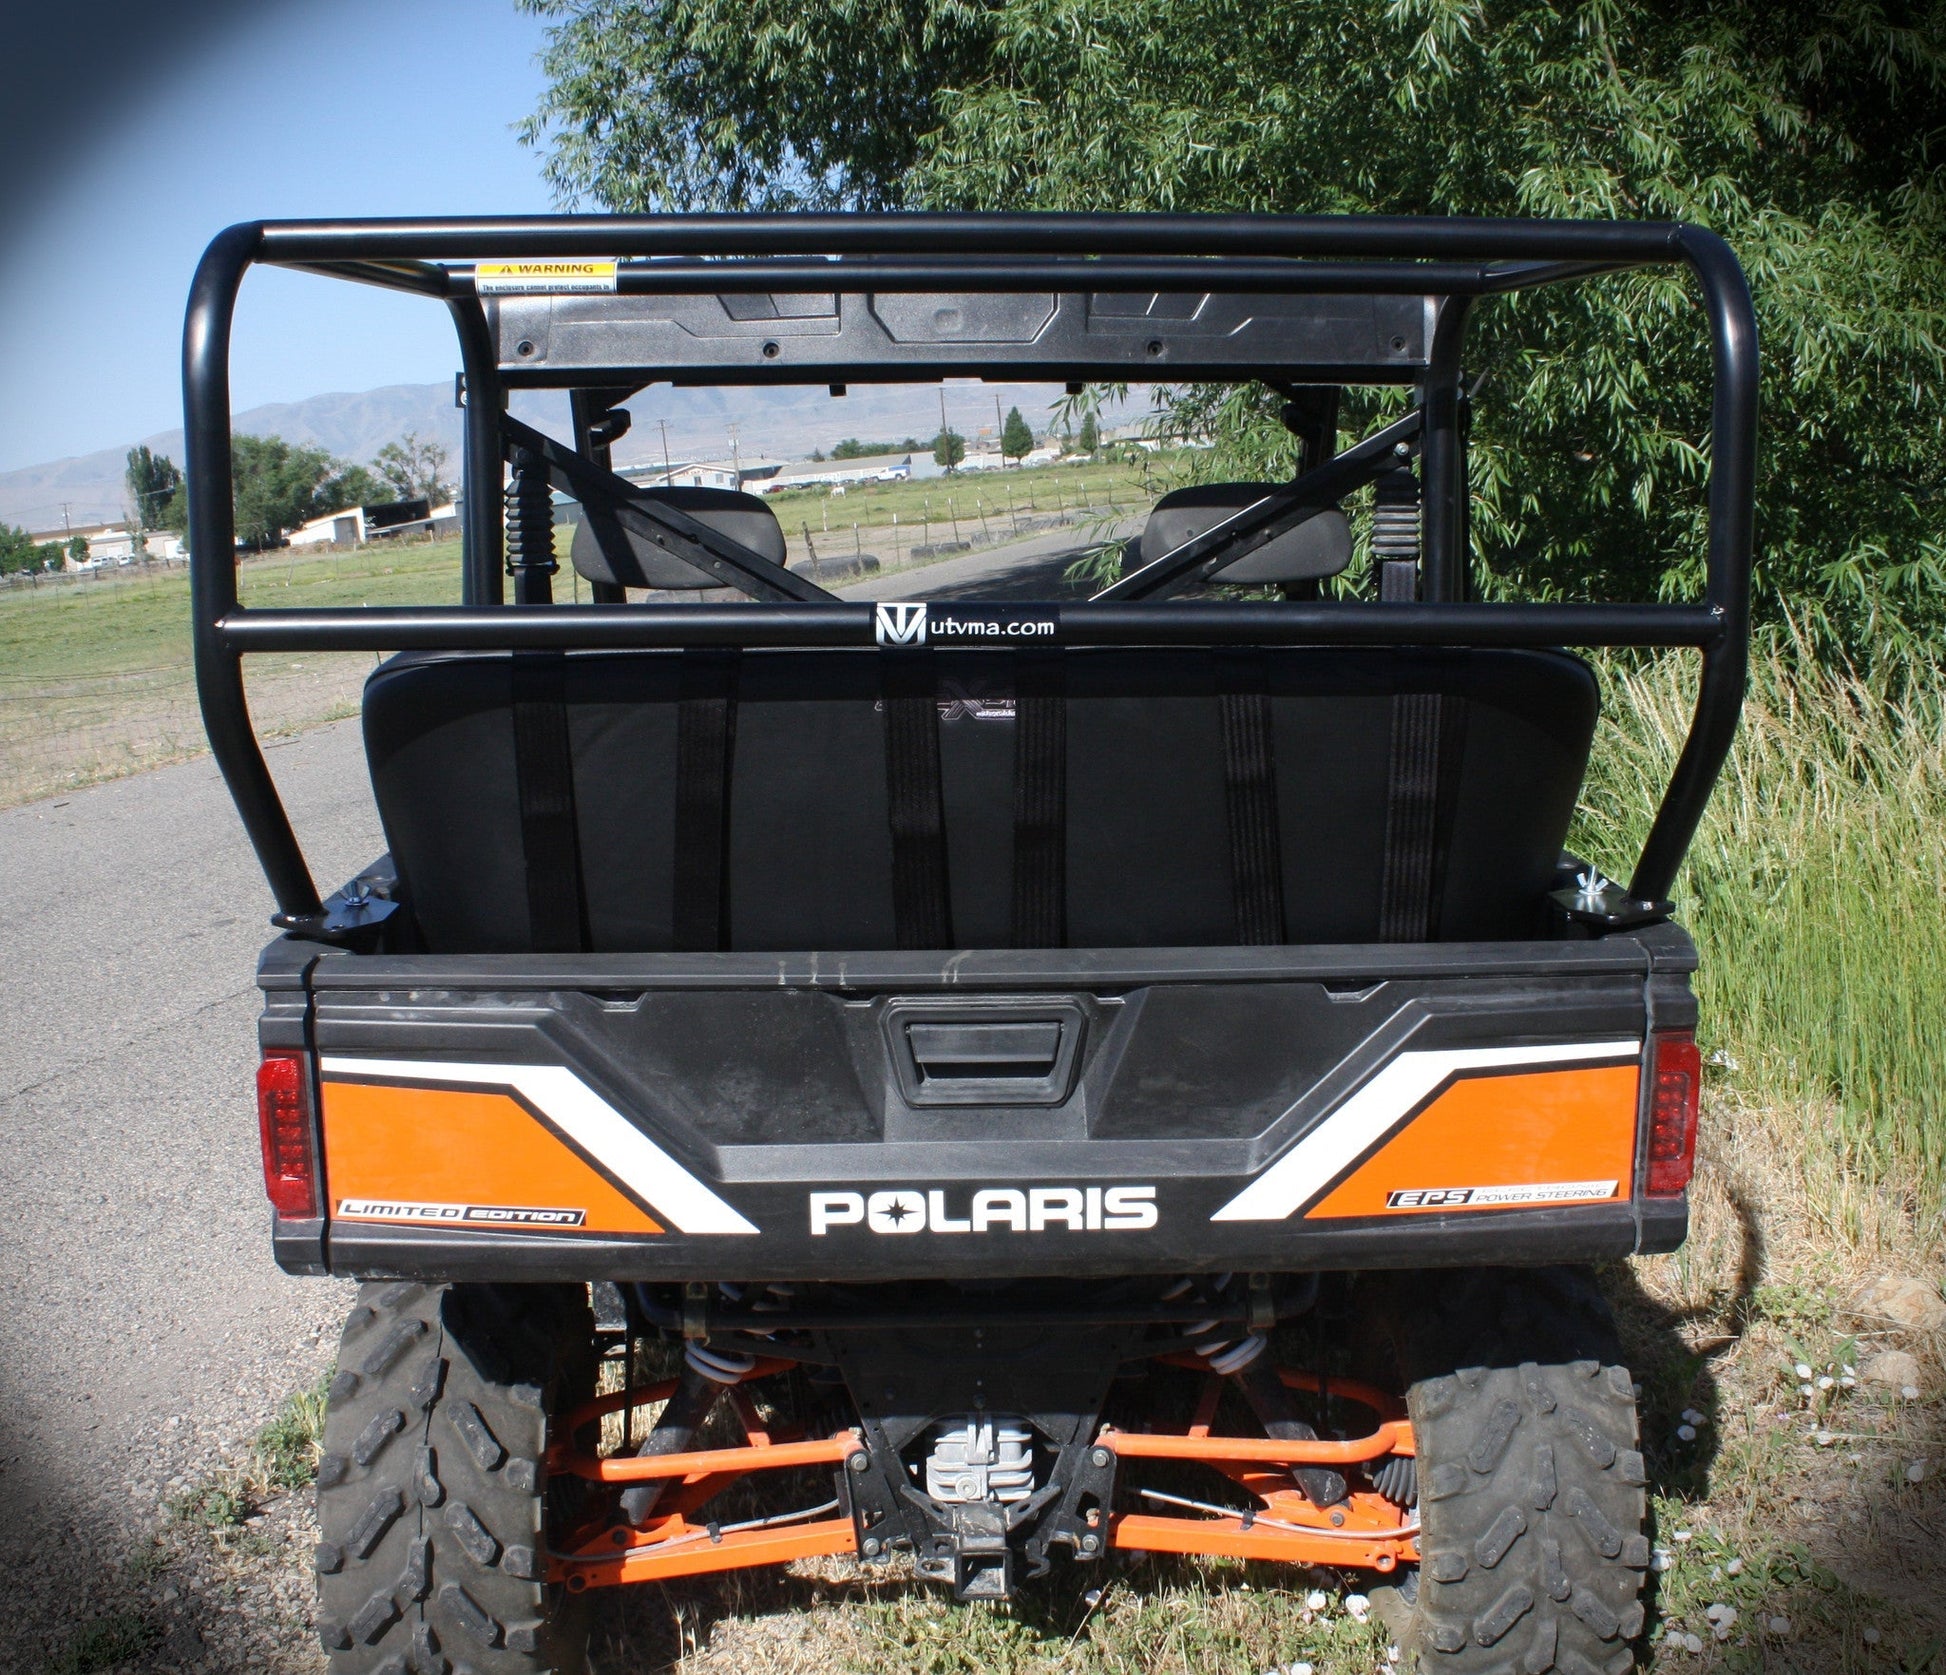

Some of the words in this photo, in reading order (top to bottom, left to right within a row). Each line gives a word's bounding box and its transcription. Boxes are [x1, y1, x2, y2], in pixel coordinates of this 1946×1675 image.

[518, 264, 594, 274] WARNING
[930, 616, 1055, 636] utvma.com
[1396, 1190, 1469, 1206] EPS
[1475, 1192, 1532, 1202] POWER
[1535, 1188, 1609, 1200] STEERING
[343, 1203, 460, 1218] LIMITED
[468, 1209, 577, 1223] EDITION
[809, 1186, 1159, 1235] POLARIS
